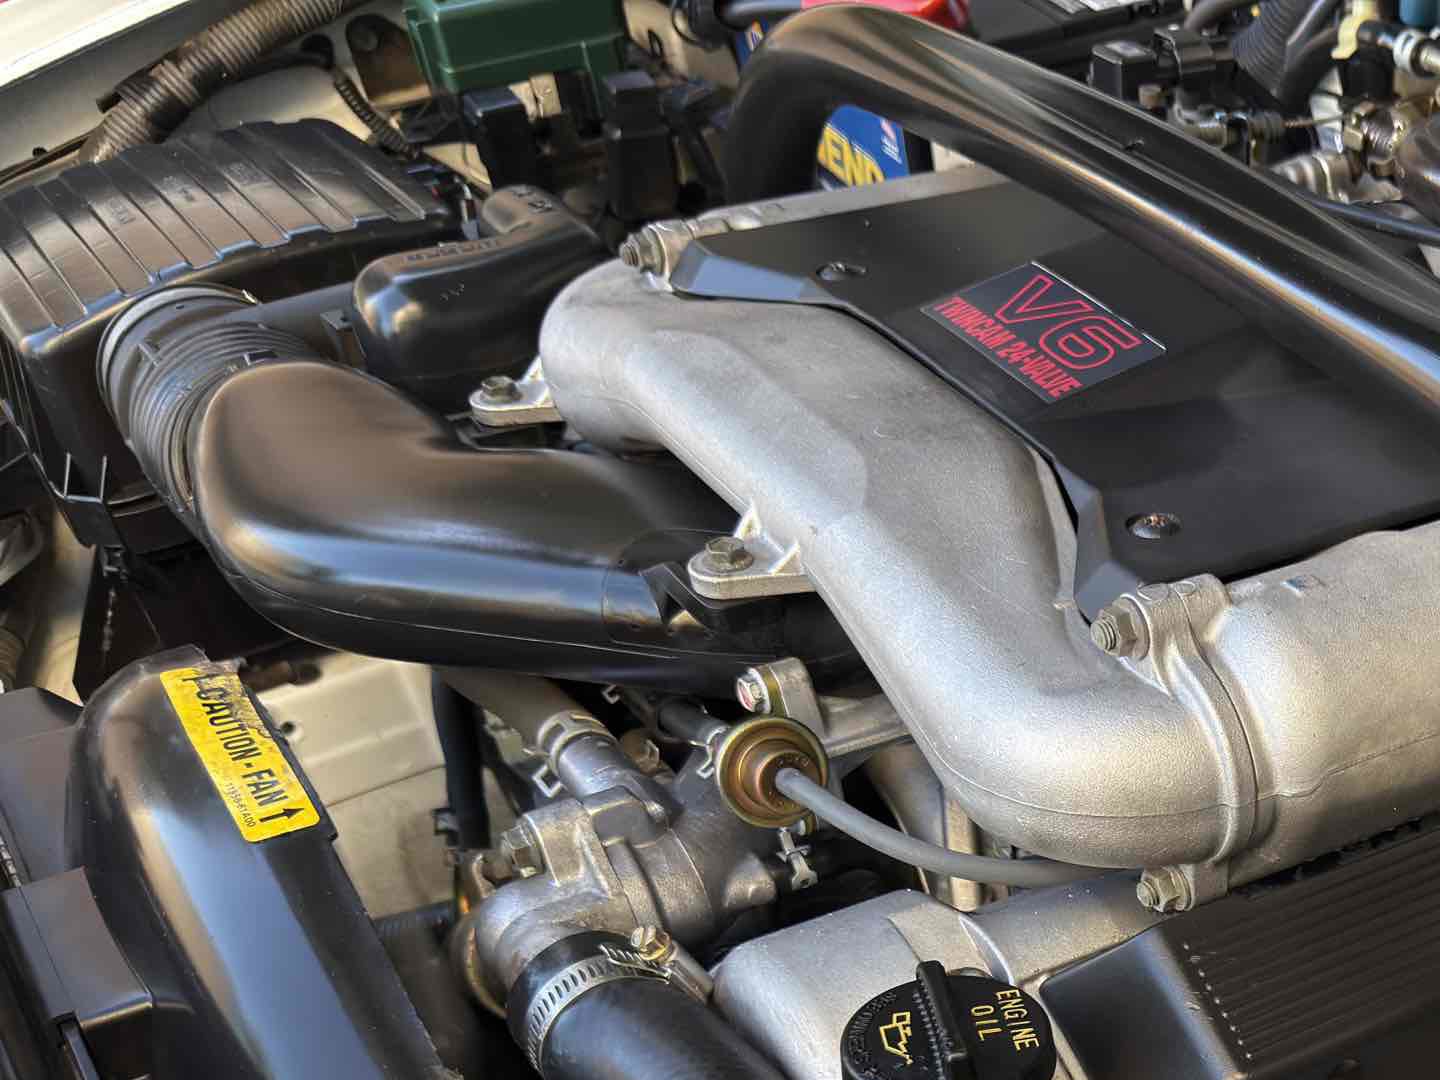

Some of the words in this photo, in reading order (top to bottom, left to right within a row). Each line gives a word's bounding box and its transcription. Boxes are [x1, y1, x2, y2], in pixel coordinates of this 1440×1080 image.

[934, 296, 1017, 350] TWINCAM
[996, 340, 1084, 400] 24-VALVE
[994, 273, 1143, 370] V6
[196, 687, 262, 762] CAUTION
[241, 767, 289, 807] FAN
[970, 1004, 1003, 1042] OIL
[995, 988, 1040, 1052] ENGINE
